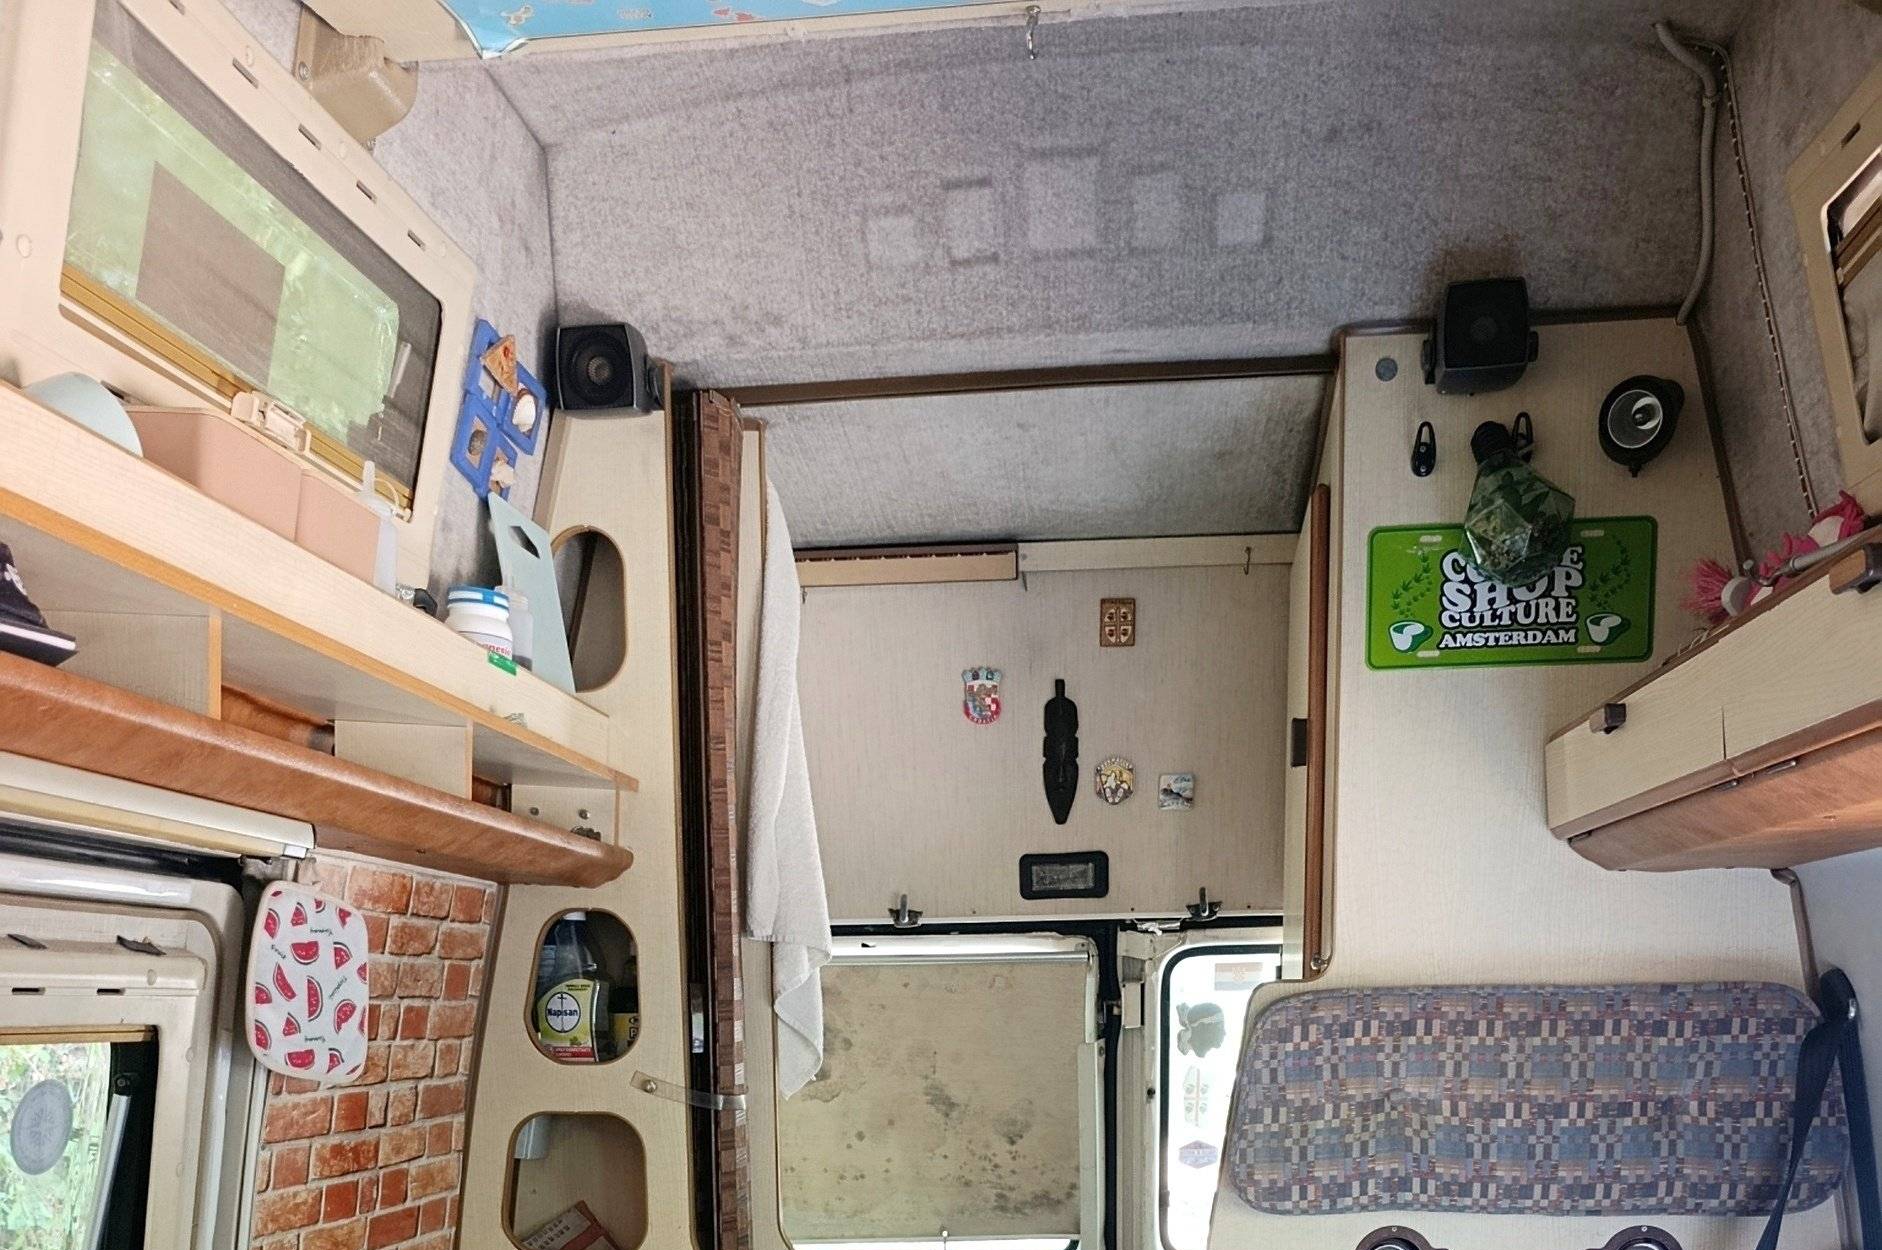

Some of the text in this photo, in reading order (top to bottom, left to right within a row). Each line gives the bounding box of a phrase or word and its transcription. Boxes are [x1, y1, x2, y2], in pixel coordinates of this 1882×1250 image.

[1441, 597, 1577, 628] CULTURE
[1439, 629, 1577, 648] AMSTERDAM
[547, 1008, 578, 1017] Napisan
